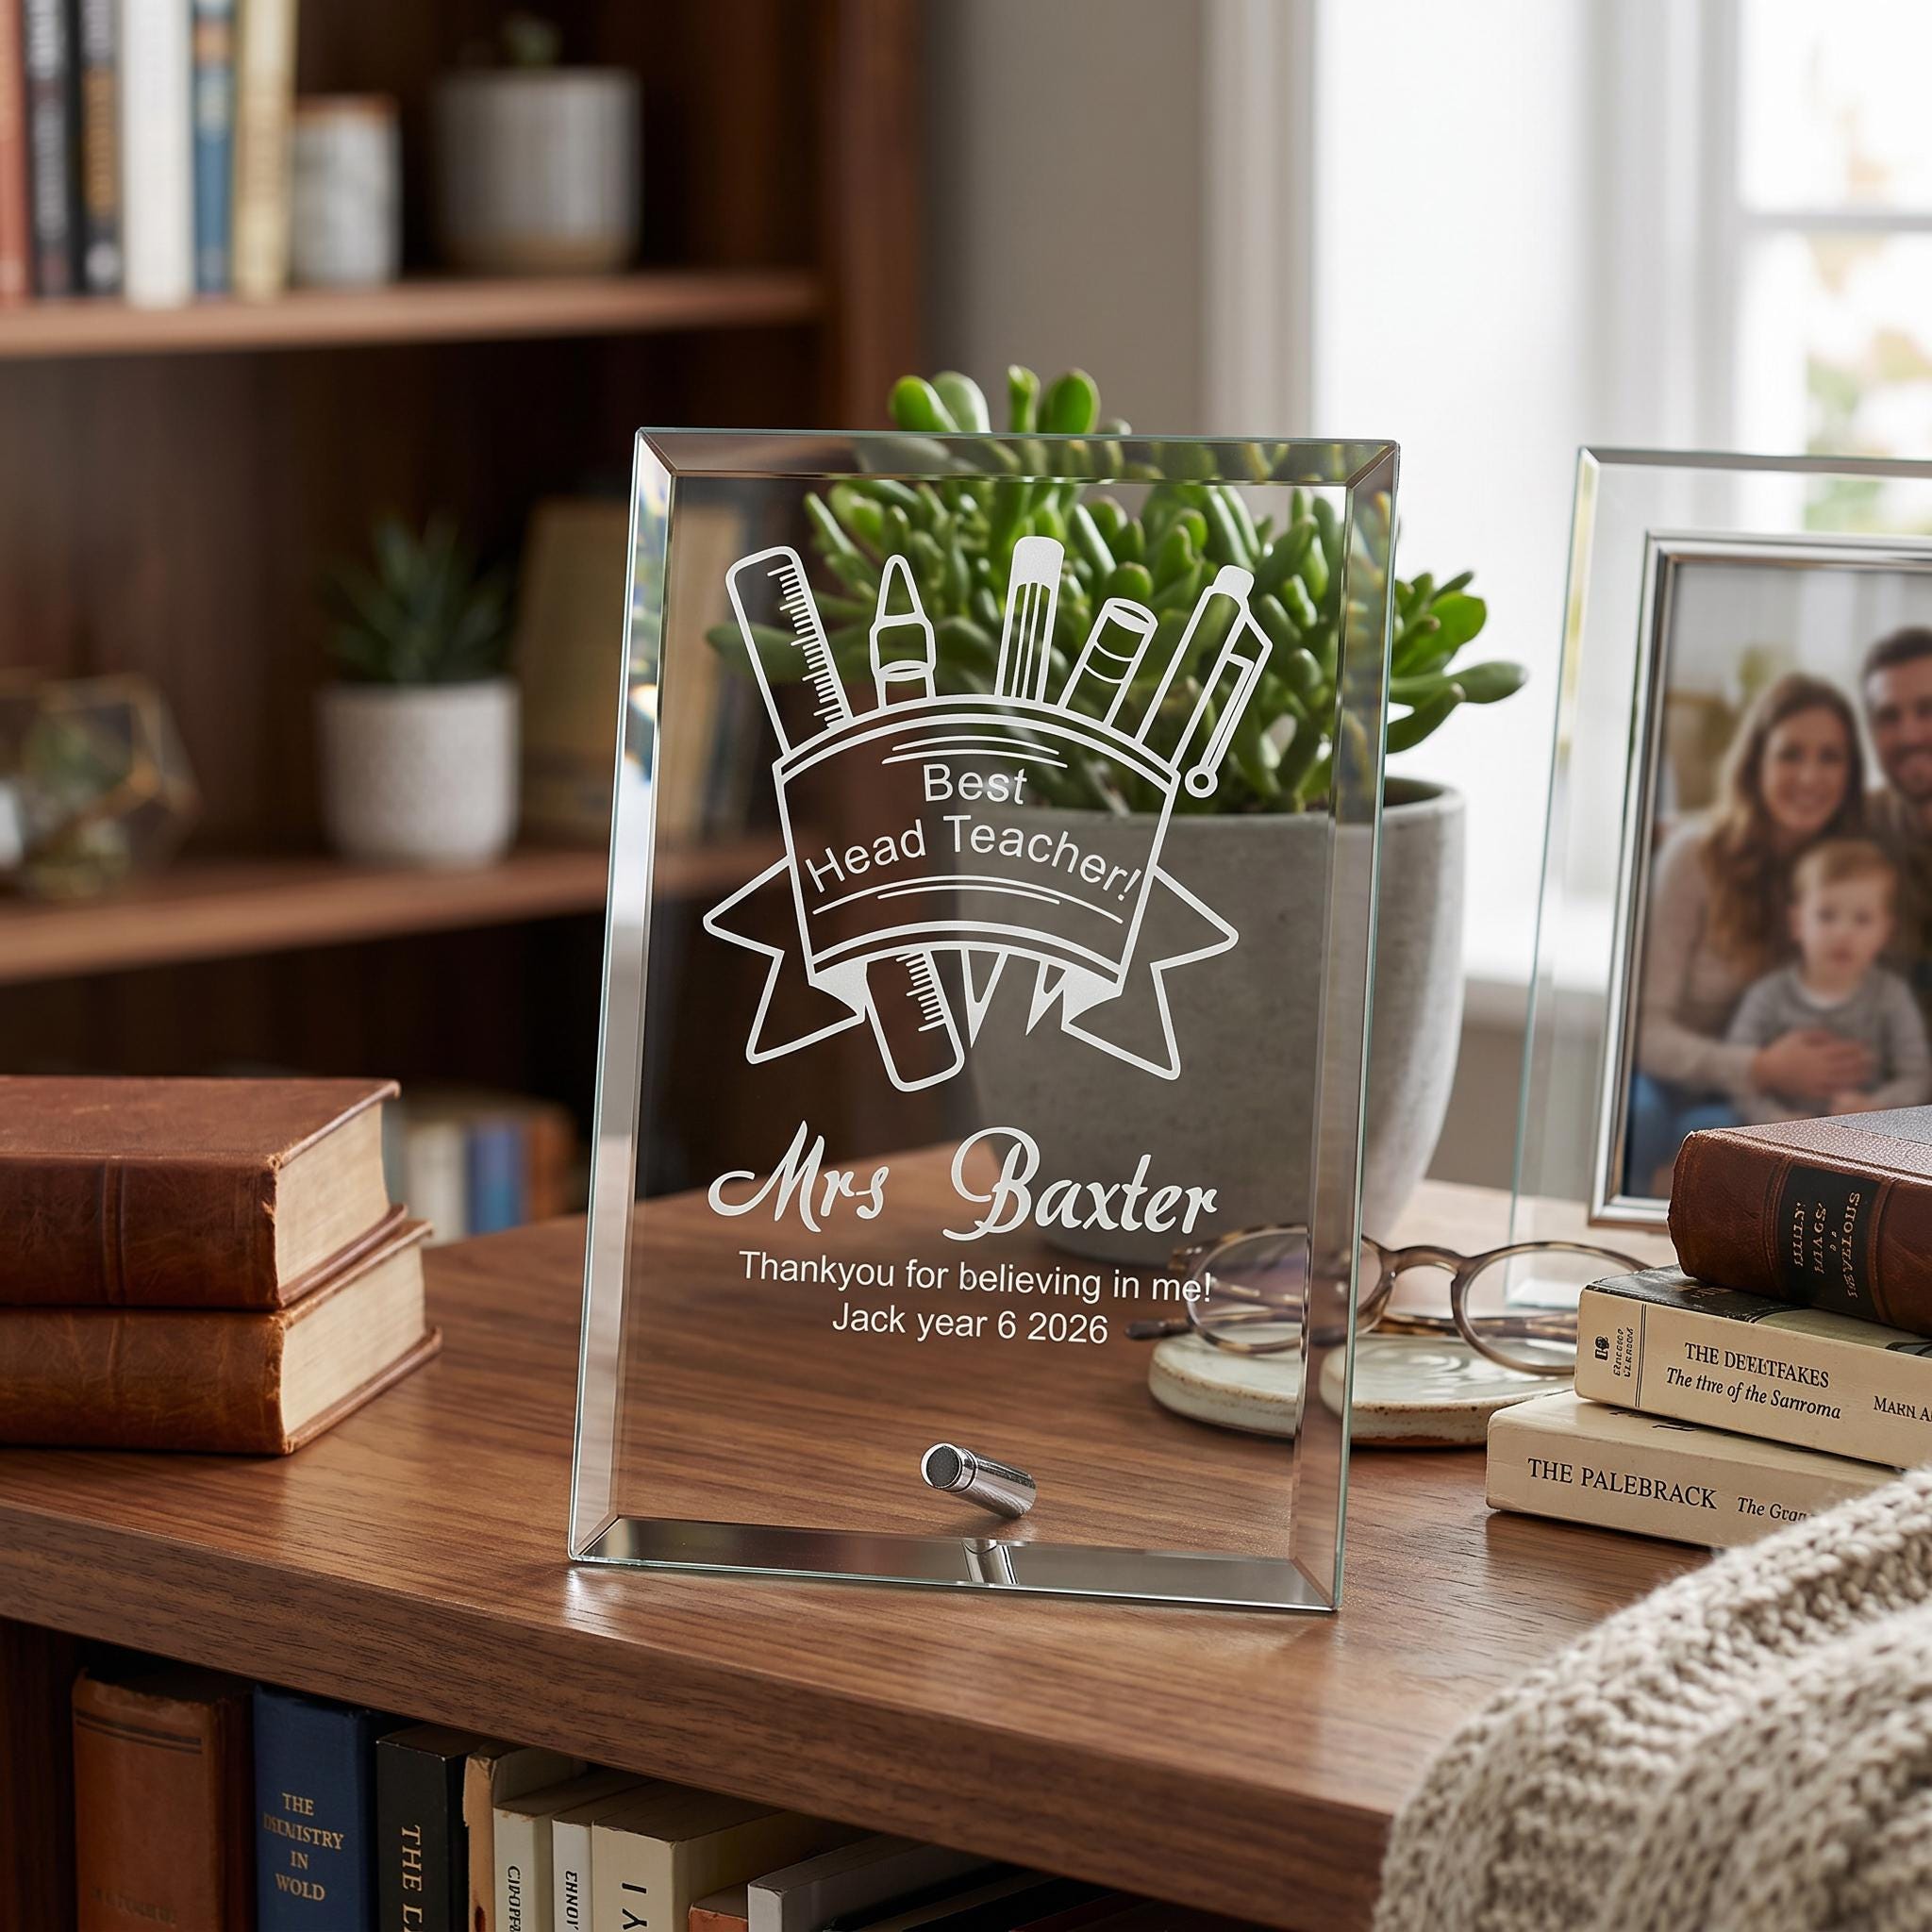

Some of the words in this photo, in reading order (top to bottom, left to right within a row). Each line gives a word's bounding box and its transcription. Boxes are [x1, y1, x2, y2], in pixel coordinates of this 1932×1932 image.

[924, 763, 1027, 805] Best
[805, 818, 926, 893] Head
[943, 814, 1142, 902] Teacher!
[708, 1120, 889, 1232] Mrs
[943, 1126, 1218, 1241] Baxter
[739, 1250, 894, 1291] Thankyou
[906, 1259, 948, 1289] for
[958, 1261, 1101, 1304] believing
[1113, 1270, 1140, 1299] in
[1152, 1273, 1211, 1303] me!
[832, 1302, 906, 1334] Jack
[917, 1309, 988, 1341] year
[997, 1311, 1016, 1339] 6
[1027, 1312, 1108, 1343] 2026
[1684, 1342, 1719, 1365] THE
[1666, 1367, 1691, 1387] The
[1727, 1381, 1744, 1403] of
[1745, 1385, 1767, 1404] the
[1920, 1407, 1932, 1423] A
[1527, 1457, 1573, 1483] THE
[1581, 1467, 1718, 1509] PALEBRACK
[1737, 1496, 1766, 1517] The
[282, 1792, 315, 1816] THE
[290, 1850, 309, 1870] IN
[401, 1824, 422, 1891] THE
[275, 1873, 326, 1902] WOLD
